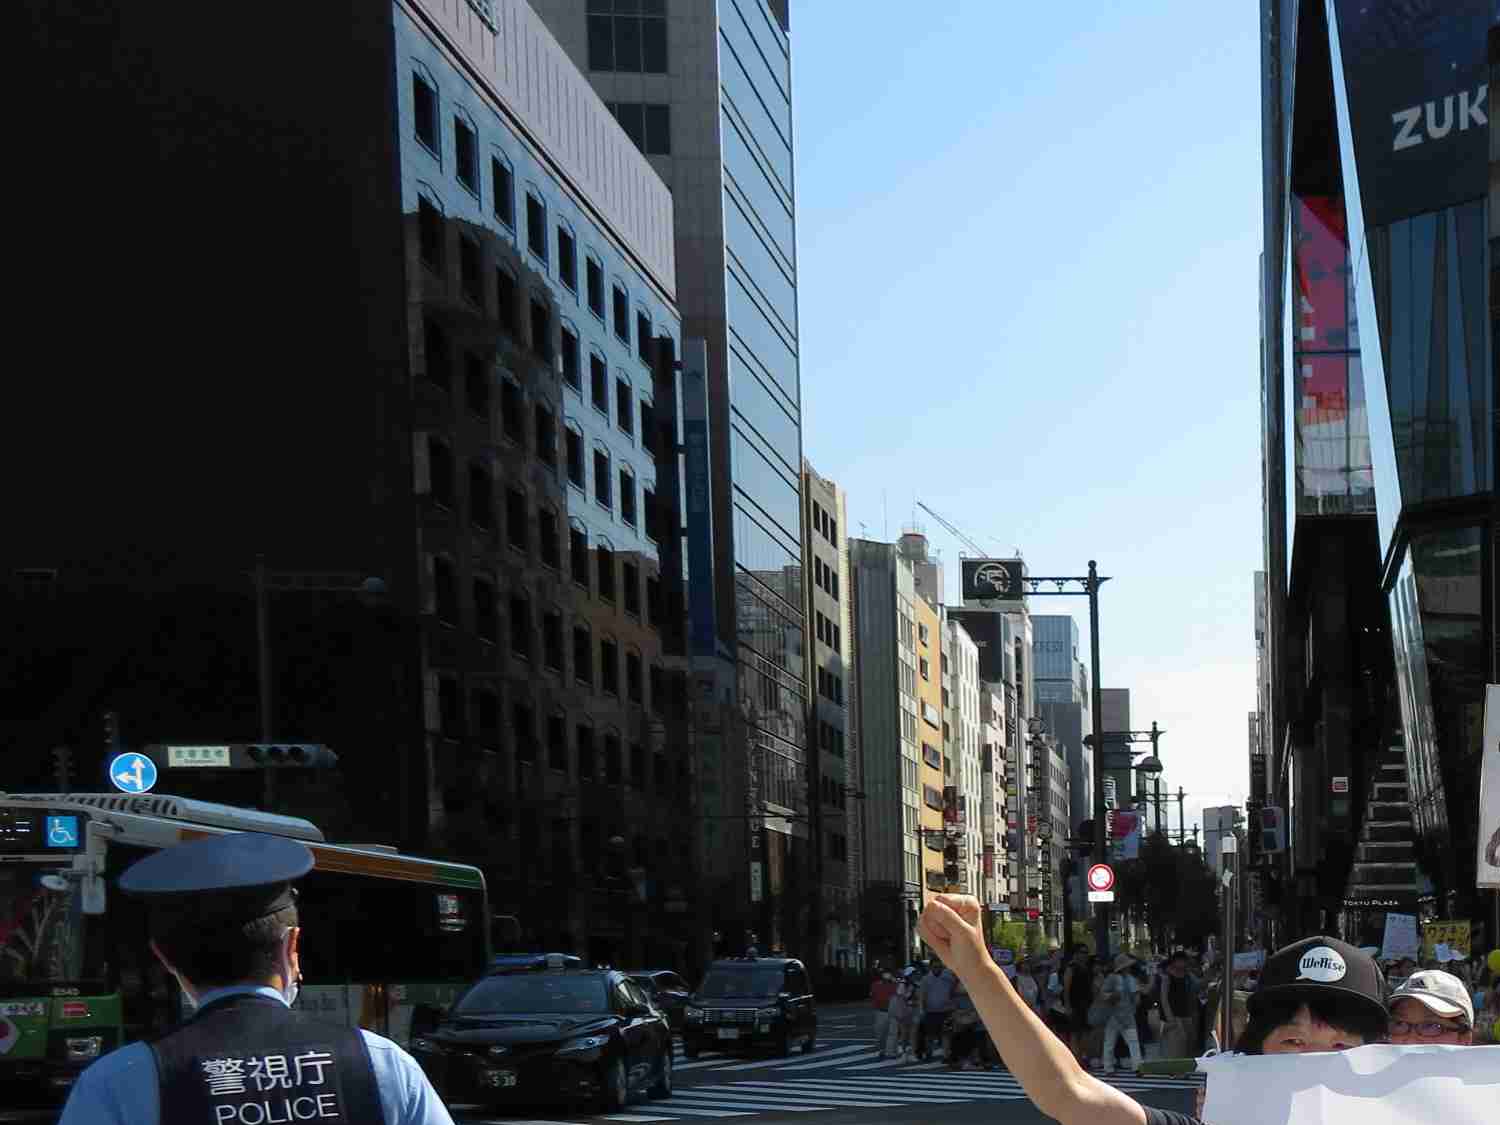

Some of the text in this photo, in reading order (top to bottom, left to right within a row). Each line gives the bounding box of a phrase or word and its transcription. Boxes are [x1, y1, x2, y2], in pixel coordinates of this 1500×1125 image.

[1302, 957, 1345, 972] WeRise
[201, 1050, 334, 1096] 警視庁
